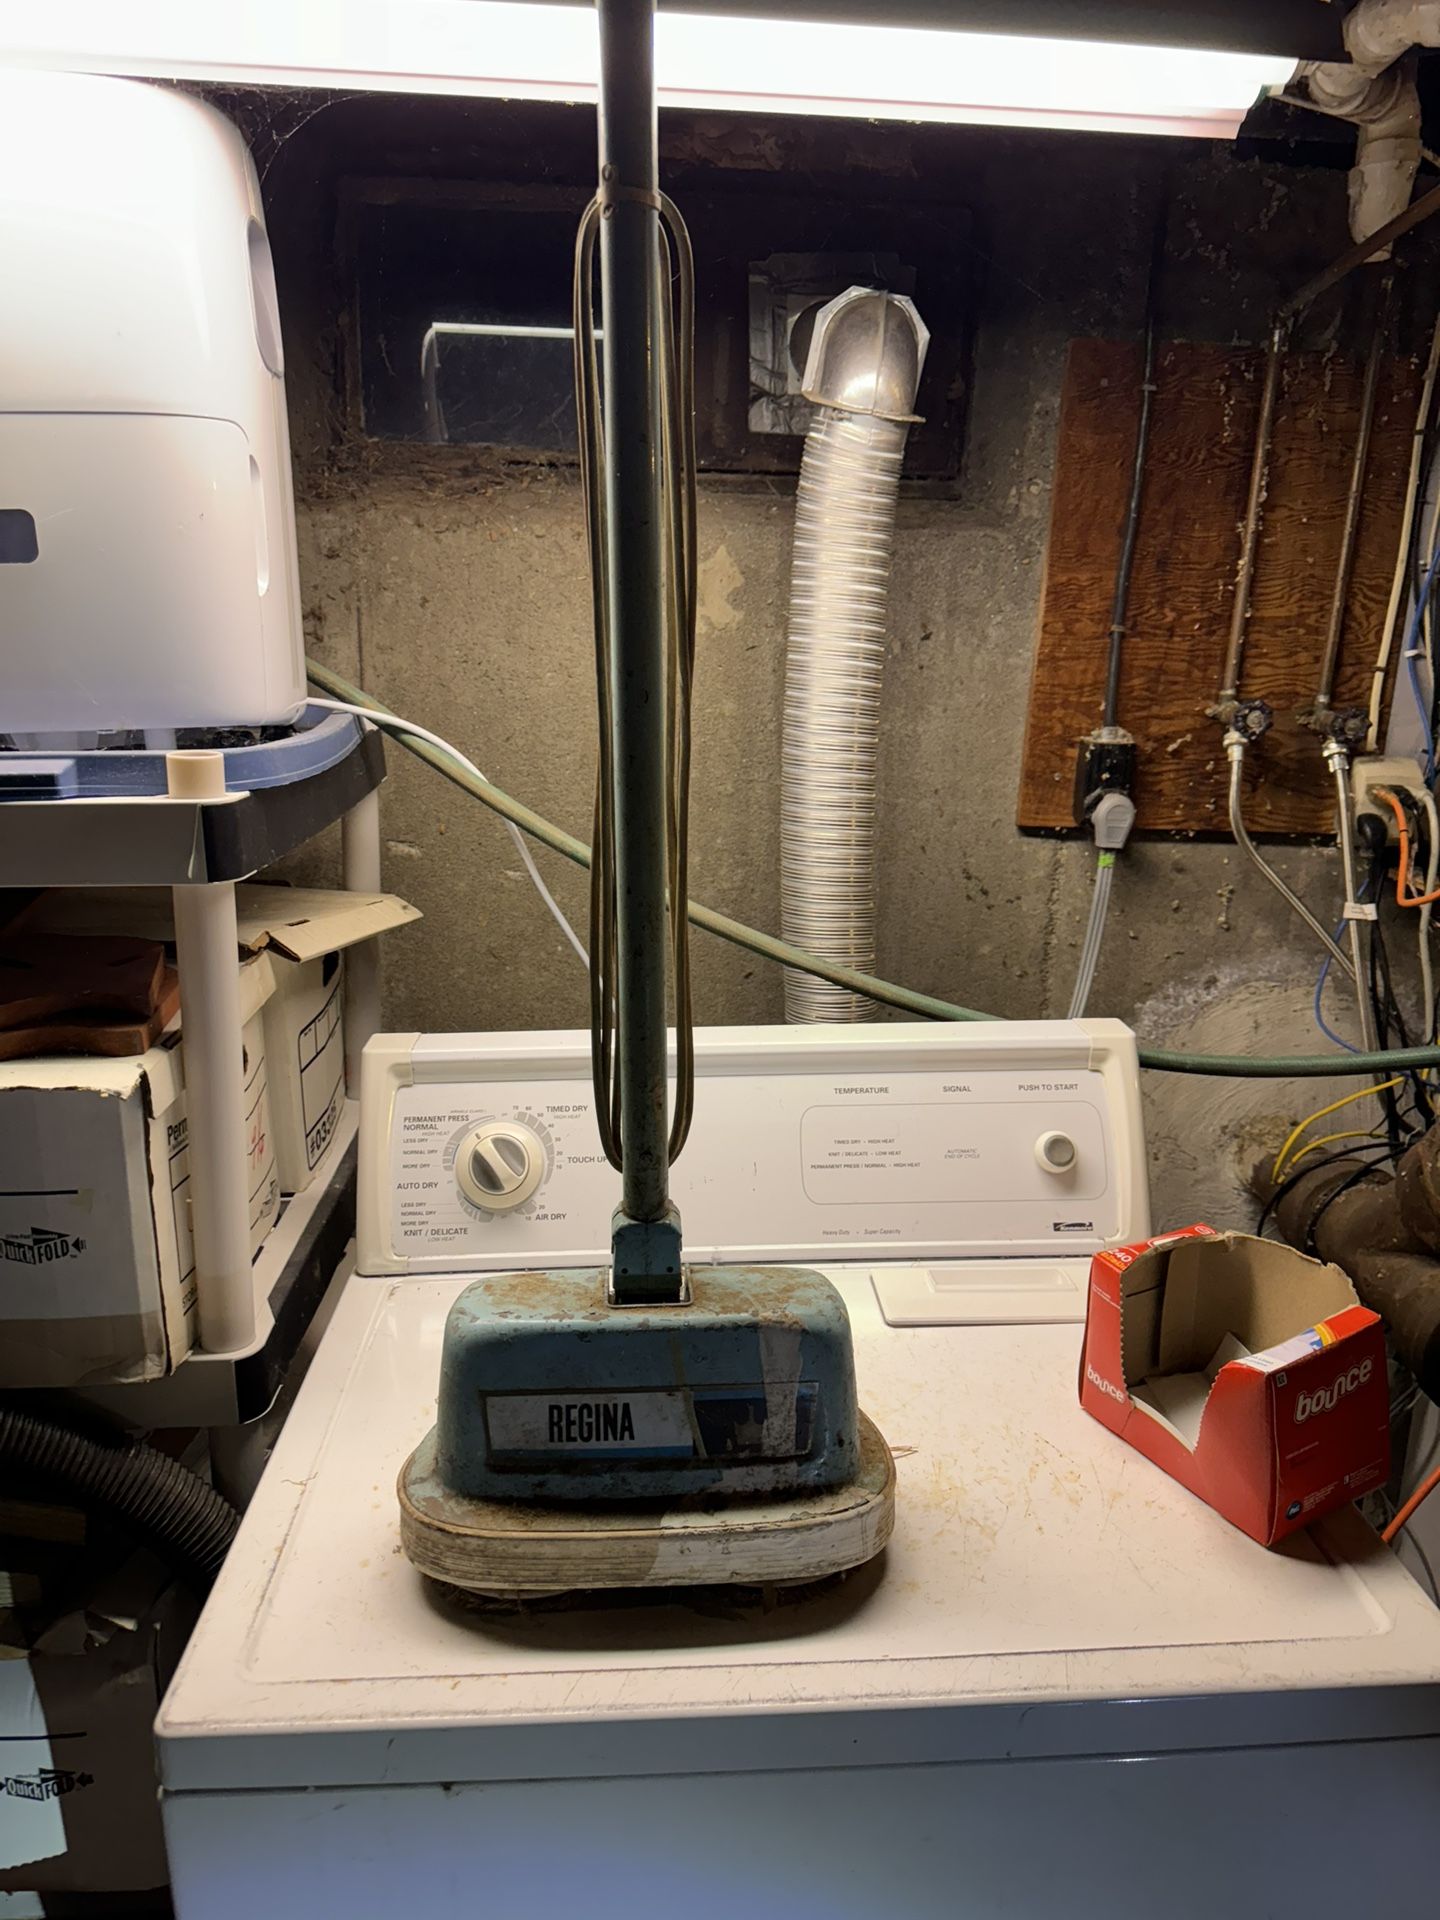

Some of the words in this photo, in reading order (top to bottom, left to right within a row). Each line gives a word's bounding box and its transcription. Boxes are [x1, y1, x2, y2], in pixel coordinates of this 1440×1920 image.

[833, 1086, 889, 1095] TEMPERATURE
[942, 1085, 972, 1093] SIGNAL
[1054, 1083, 1079, 1091] START
[545, 1105, 571, 1113] TIMED
[403, 1115, 446, 1123] PERMANENT
[403, 1123, 439, 1131] NORMAL
[567, 1156, 595, 1164] TOUCH
[397, 1182, 420, 1190] AUTO
[535, 1213, 549, 1221] AIR
[403, 1229, 423, 1237] KNIT
[430, 1227, 469, 1236] DELICATE
[1087, 1363, 1125, 1404] bounce
[1295, 1357, 1373, 1422] bounce
[547, 1402, 635, 1444] REGINA
